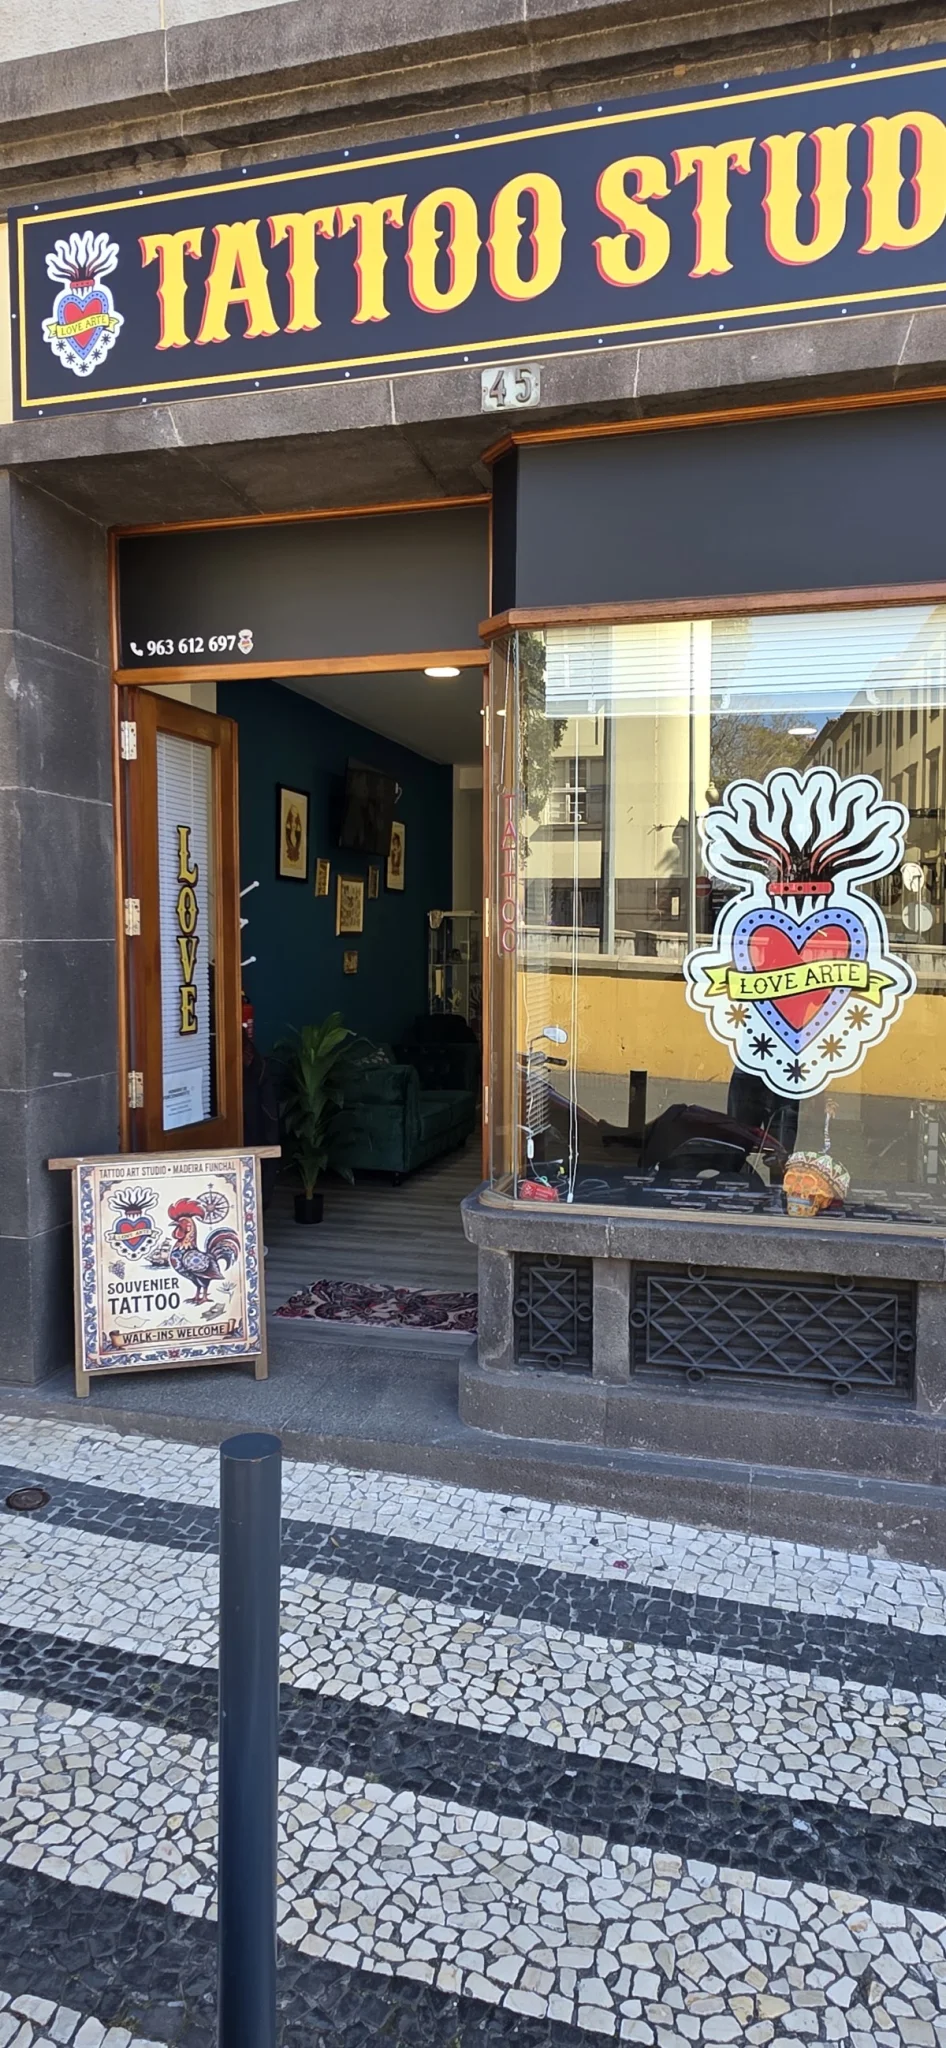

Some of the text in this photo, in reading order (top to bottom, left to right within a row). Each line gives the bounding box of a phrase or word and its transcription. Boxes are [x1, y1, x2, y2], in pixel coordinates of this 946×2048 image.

[138, 111, 946, 351] TATTOO STUD
[61, 316, 107, 336] LOVE ARTE
[489, 368, 532, 408] 45
[146, 635, 236, 656] 963 612 697
[500, 794, 517, 952] TATTOO
[176, 825, 199, 1036] LOVE
[740, 963, 861, 994] LOVE ARTE
[99, 1160, 237, 1179] TATTOO ART STUDIO MADEIRA FUNCHAL
[107, 1277, 180, 1295] SOUVENIER
[108, 1292, 180, 1315] TATTOO
[122, 1324, 226, 1344] WALK-INS WELCOME
